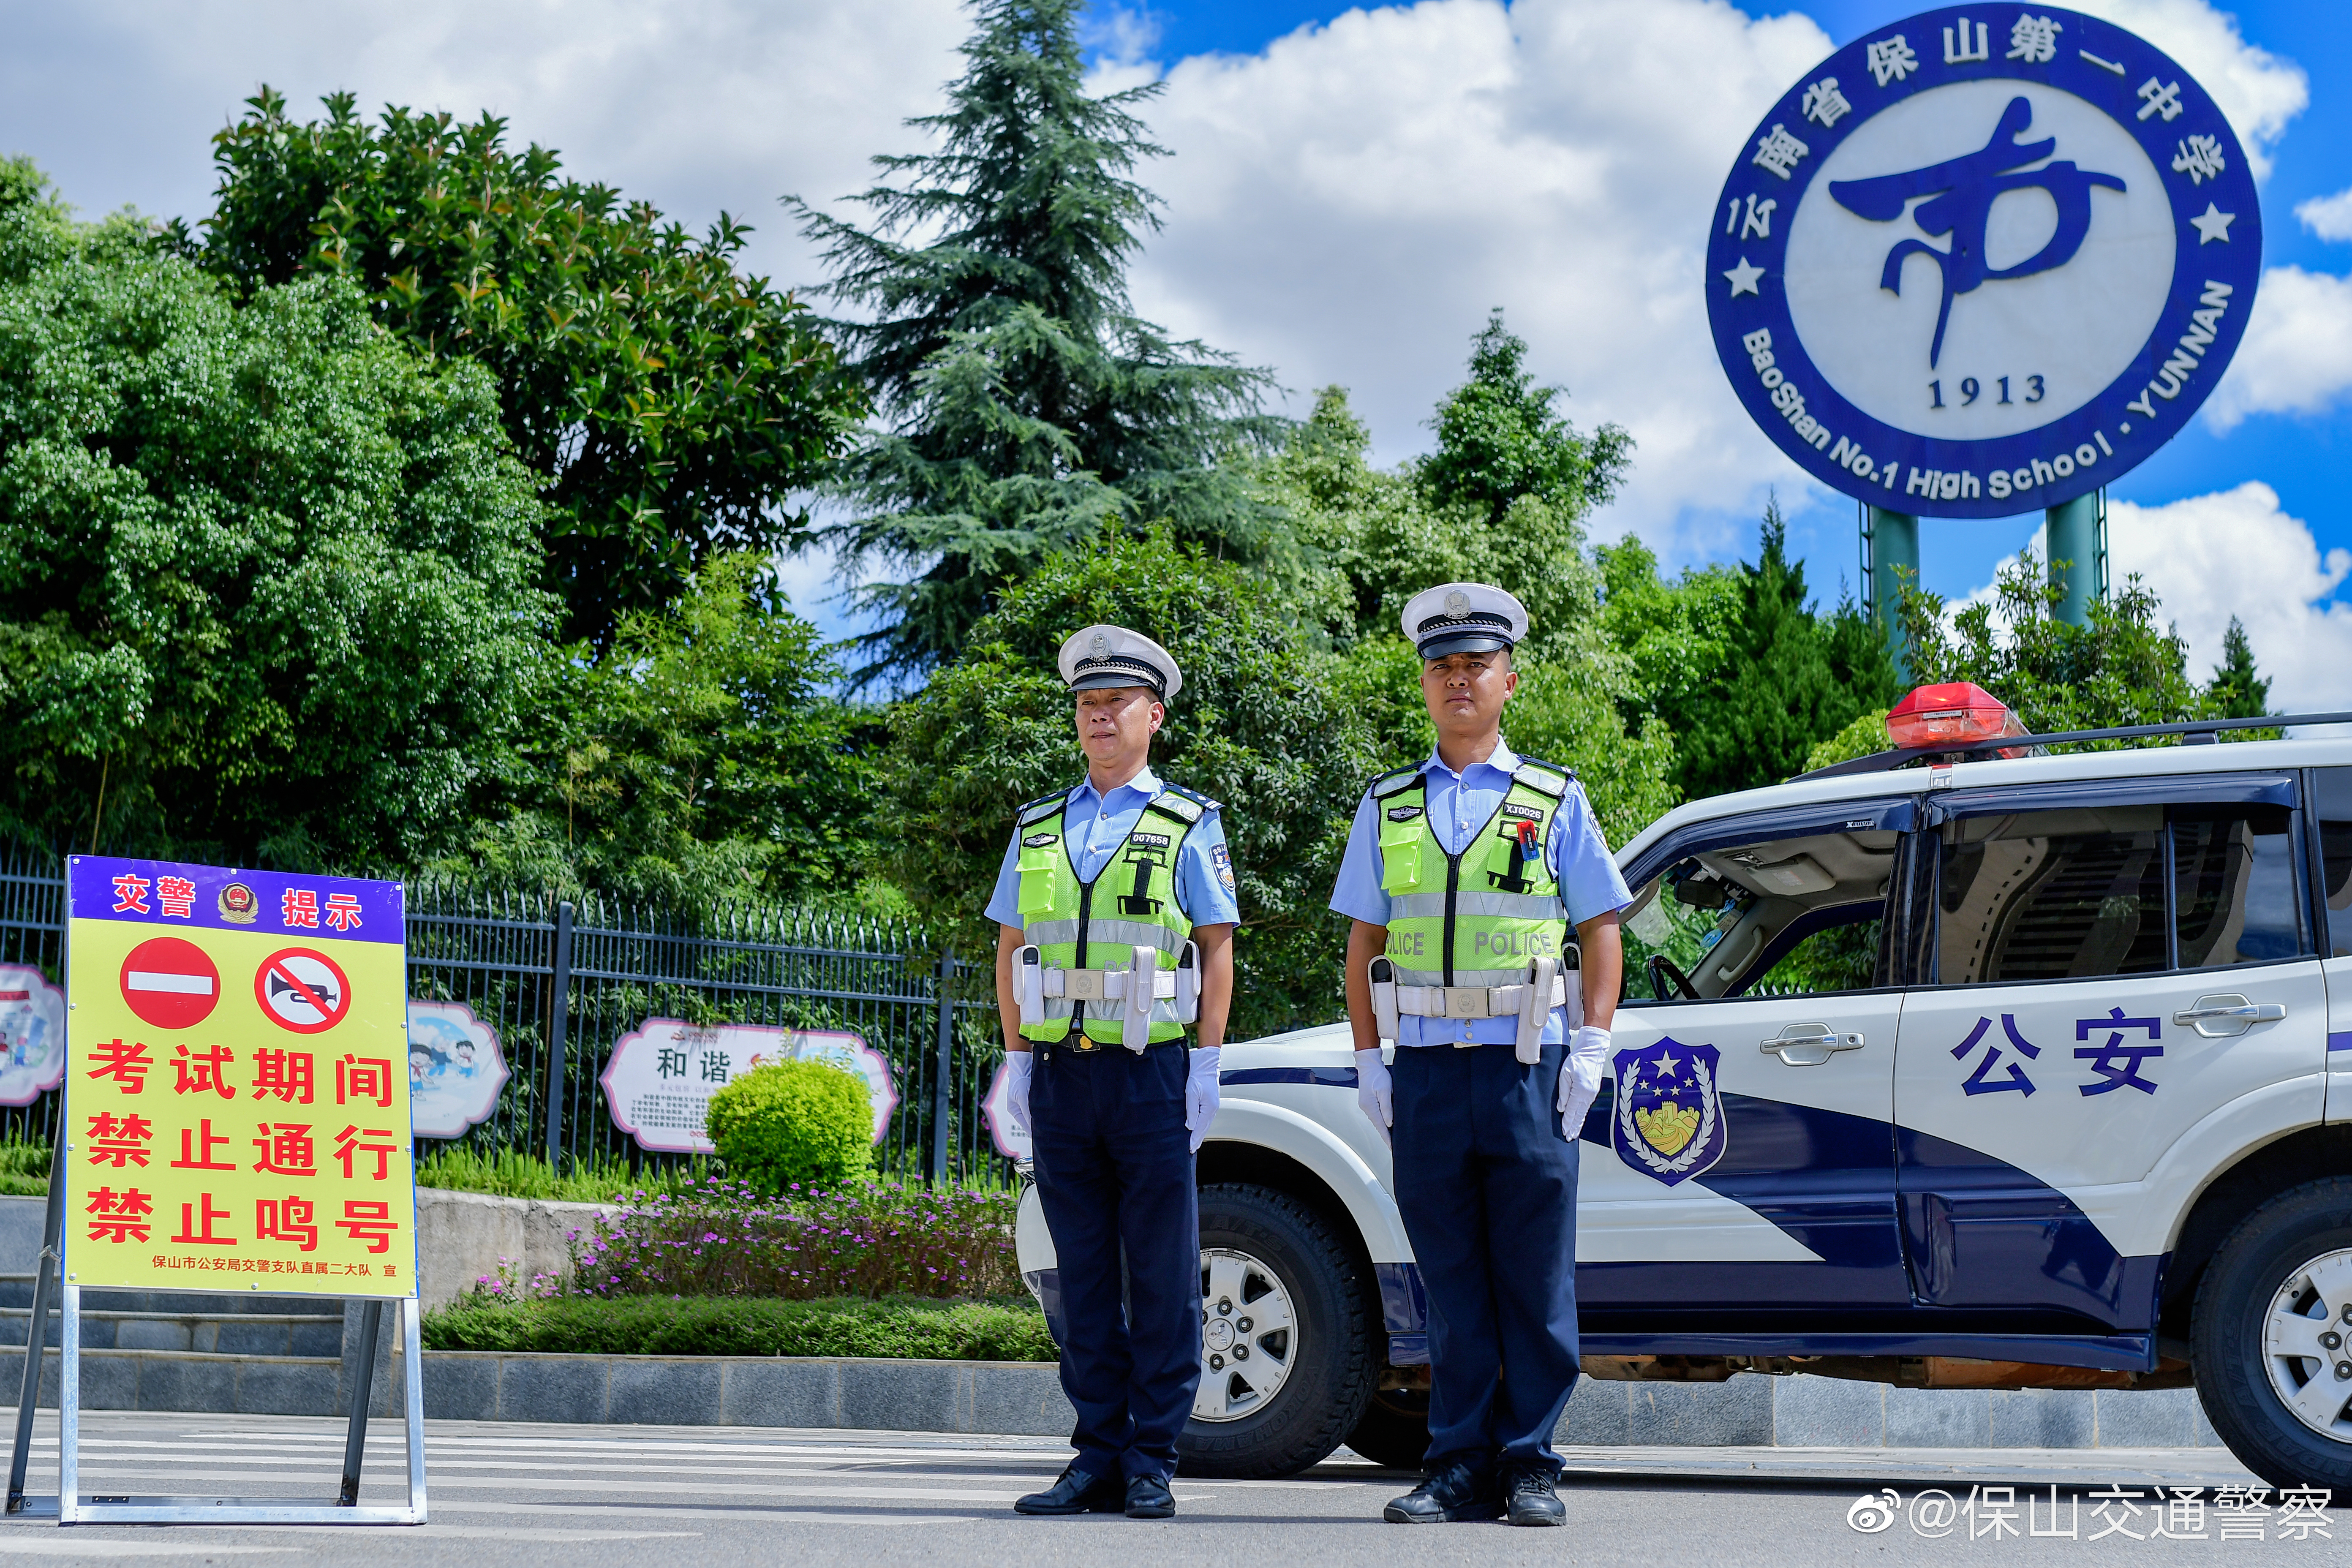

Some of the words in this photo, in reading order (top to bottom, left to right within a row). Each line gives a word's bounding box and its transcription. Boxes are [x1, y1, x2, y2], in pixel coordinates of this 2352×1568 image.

[1726, 13, 2225, 240] 云南省保山第一中学
[1742, 327, 1832, 451] BaoShan
[1828, 434, 1899, 490] No.1
[1905, 466, 1980, 500] High
[1988, 429, 2113, 499] School
[2126, 279, 2234, 419] YUNNAN
[1929, 375, 2045, 409] 1913
[1132, 834, 1169, 845] 007658
[1505, 805, 1541, 819] XJ0026
[112, 874, 196, 918] 交警
[281, 888, 363, 931] 提示
[1386, 931, 1424, 956] OLICE
[1475, 931, 1556, 956] POLICE
[87, 1038, 392, 1108] 考试期间
[657, 1047, 731, 1083] 和谐
[1950, 1007, 2164, 1098] 公安
[86, 1112, 397, 1181] 禁止通行
[86, 1186, 398, 1253] 禁止鸣号
[152, 1255, 372, 1277] 保山市公安局交警支队直属二大队
[383, 1264, 397, 1277] 宣
